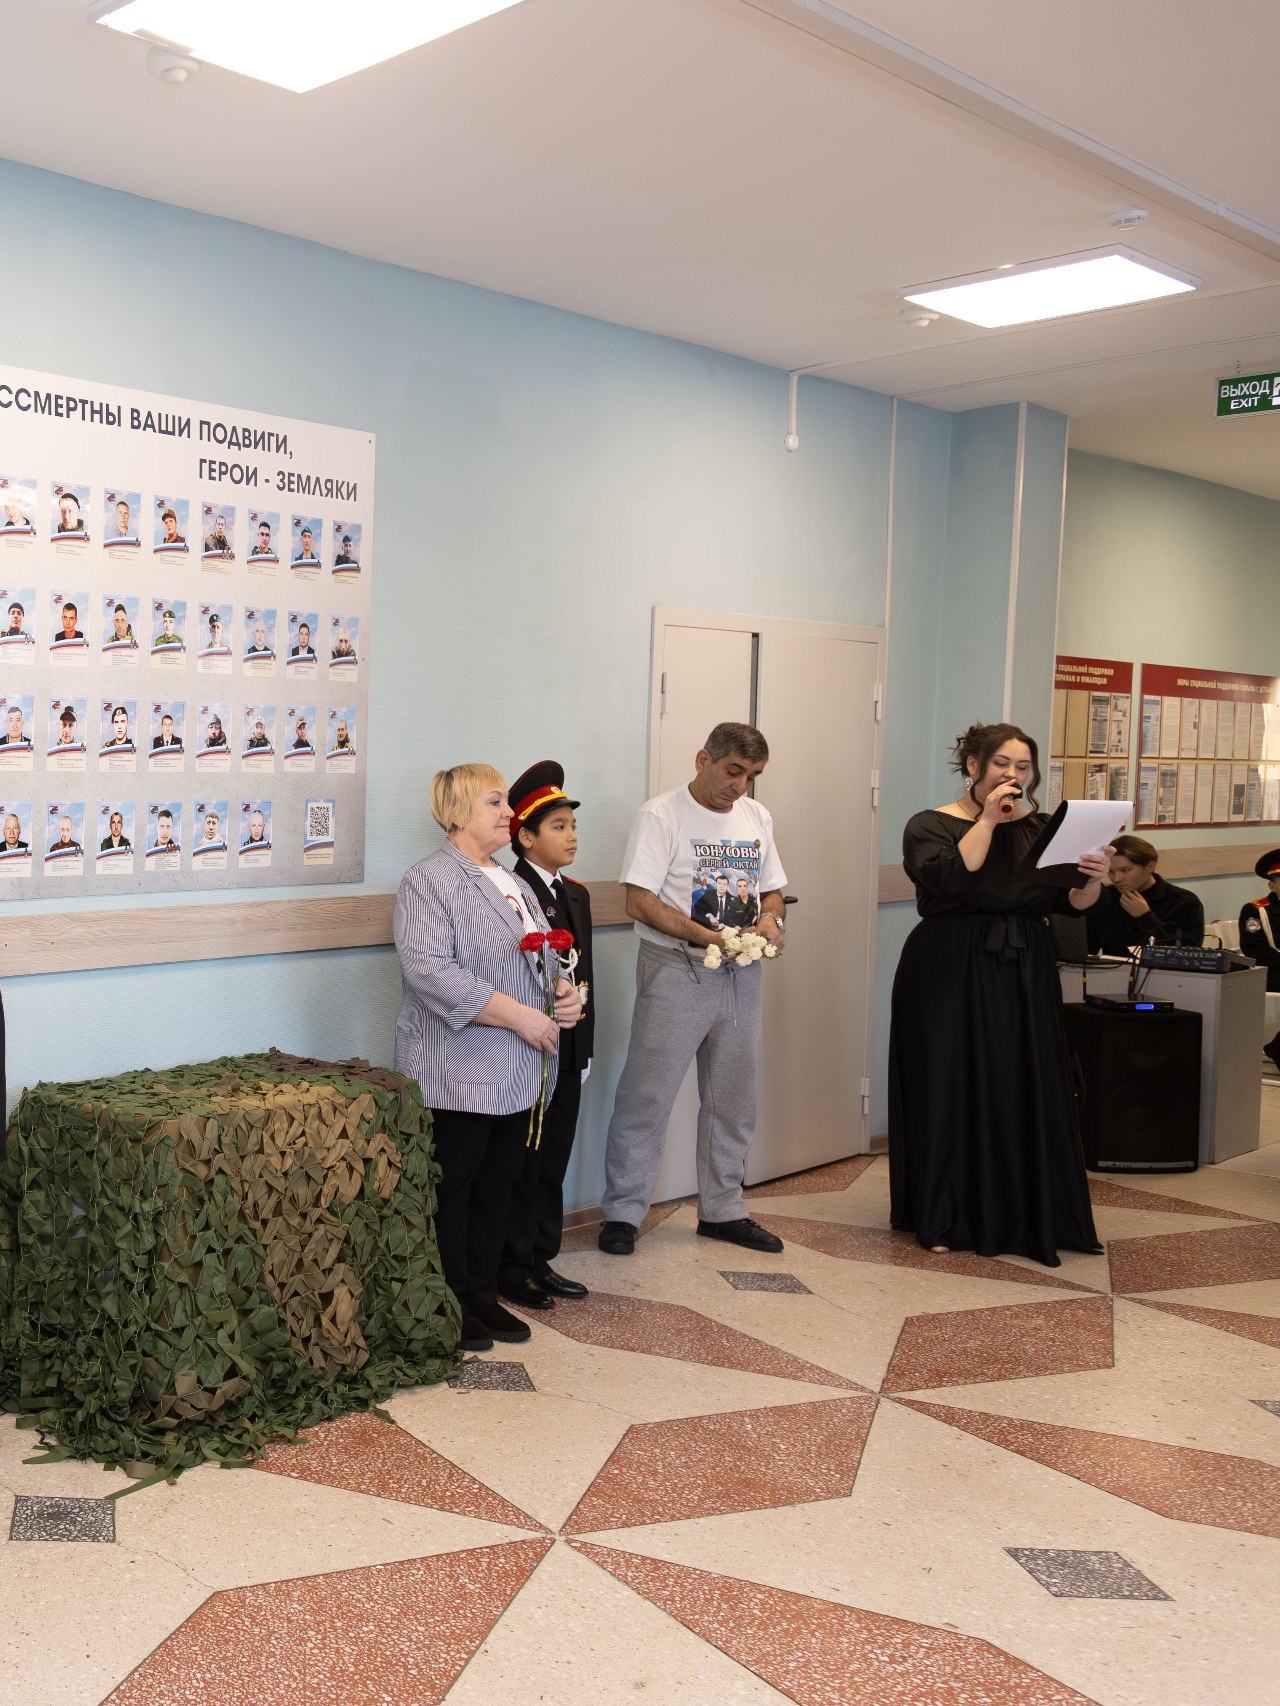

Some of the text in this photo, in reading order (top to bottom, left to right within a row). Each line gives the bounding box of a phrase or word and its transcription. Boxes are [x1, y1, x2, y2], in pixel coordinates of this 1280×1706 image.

[1221, 380, 1270, 398] ВЫХОД
[1230, 396, 1261, 409] EXIT
[131, 408, 191, 438] ВАШИ
[200, 420, 294, 459] ПОДВИГИ,
[200, 459, 258, 487] ГЕРОИ
[277, 471, 358, 502] ЗЕМЛЯКИ
[694, 844, 759, 859] ЮНУСОВЫ
[700, 858, 759, 870] СЕРГЕЙ ОКТАЙ
